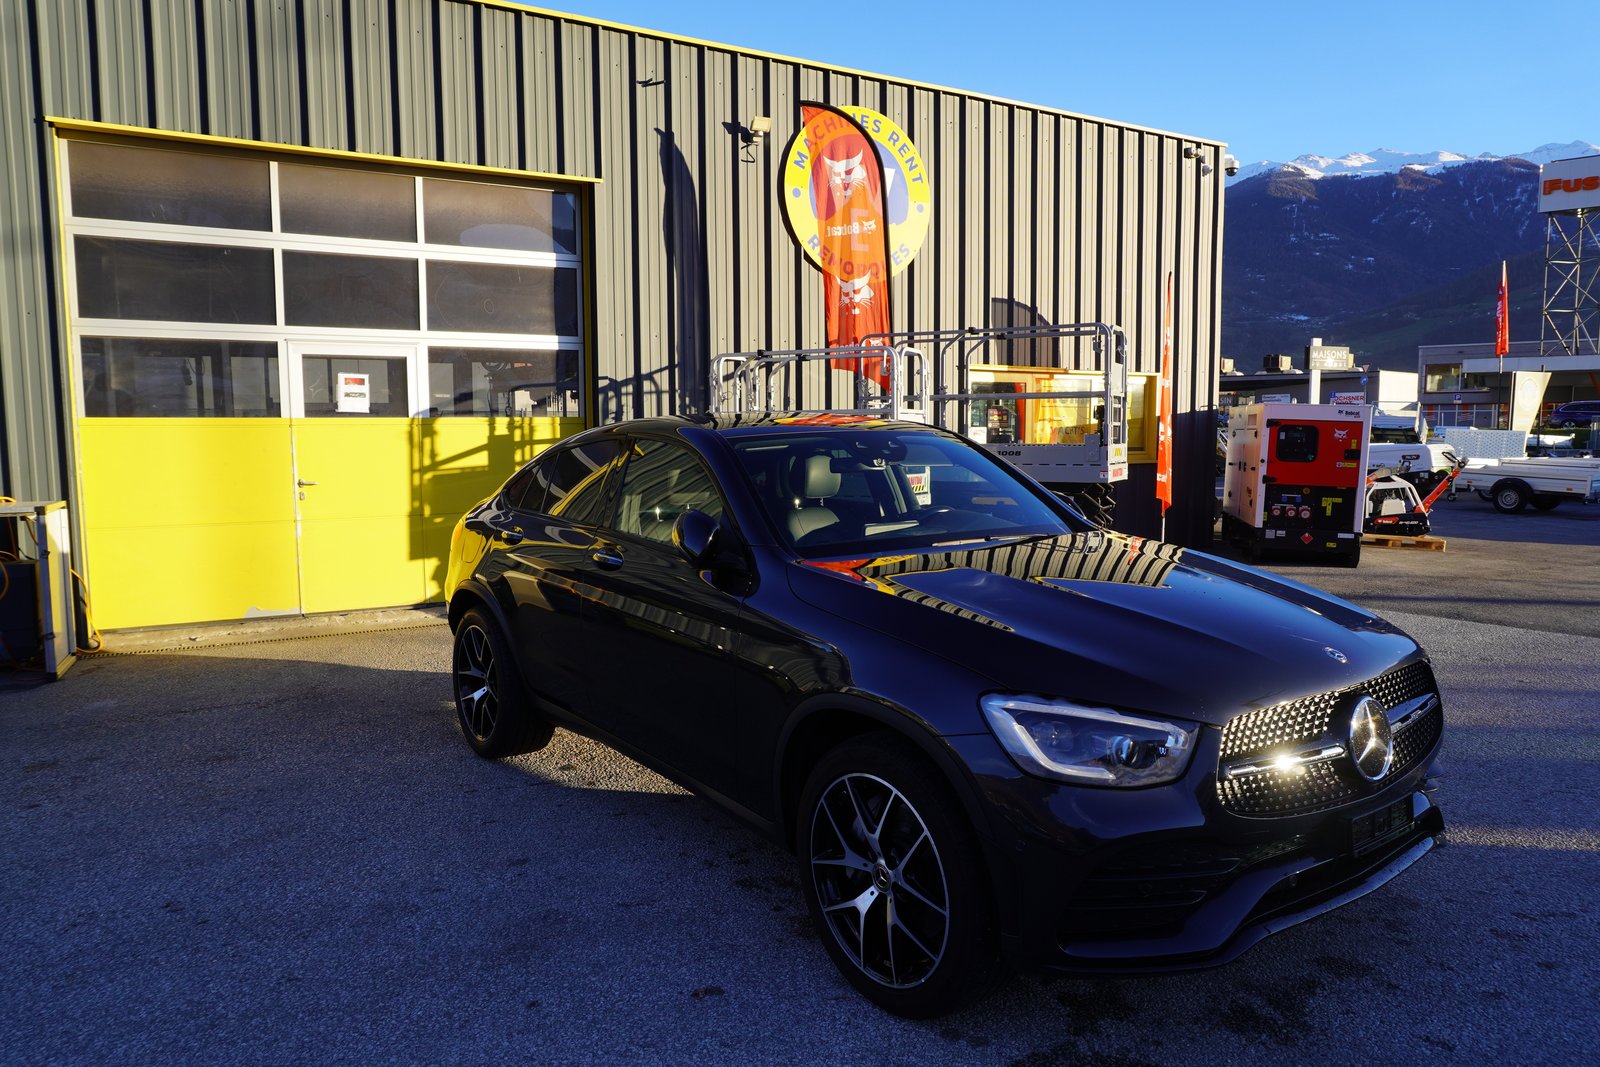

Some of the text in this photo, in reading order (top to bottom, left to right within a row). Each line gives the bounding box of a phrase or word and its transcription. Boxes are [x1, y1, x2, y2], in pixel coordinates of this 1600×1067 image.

[793, 113, 924, 184] MACHIES RENT
[1312, 350, 1347, 359] MAISONS
